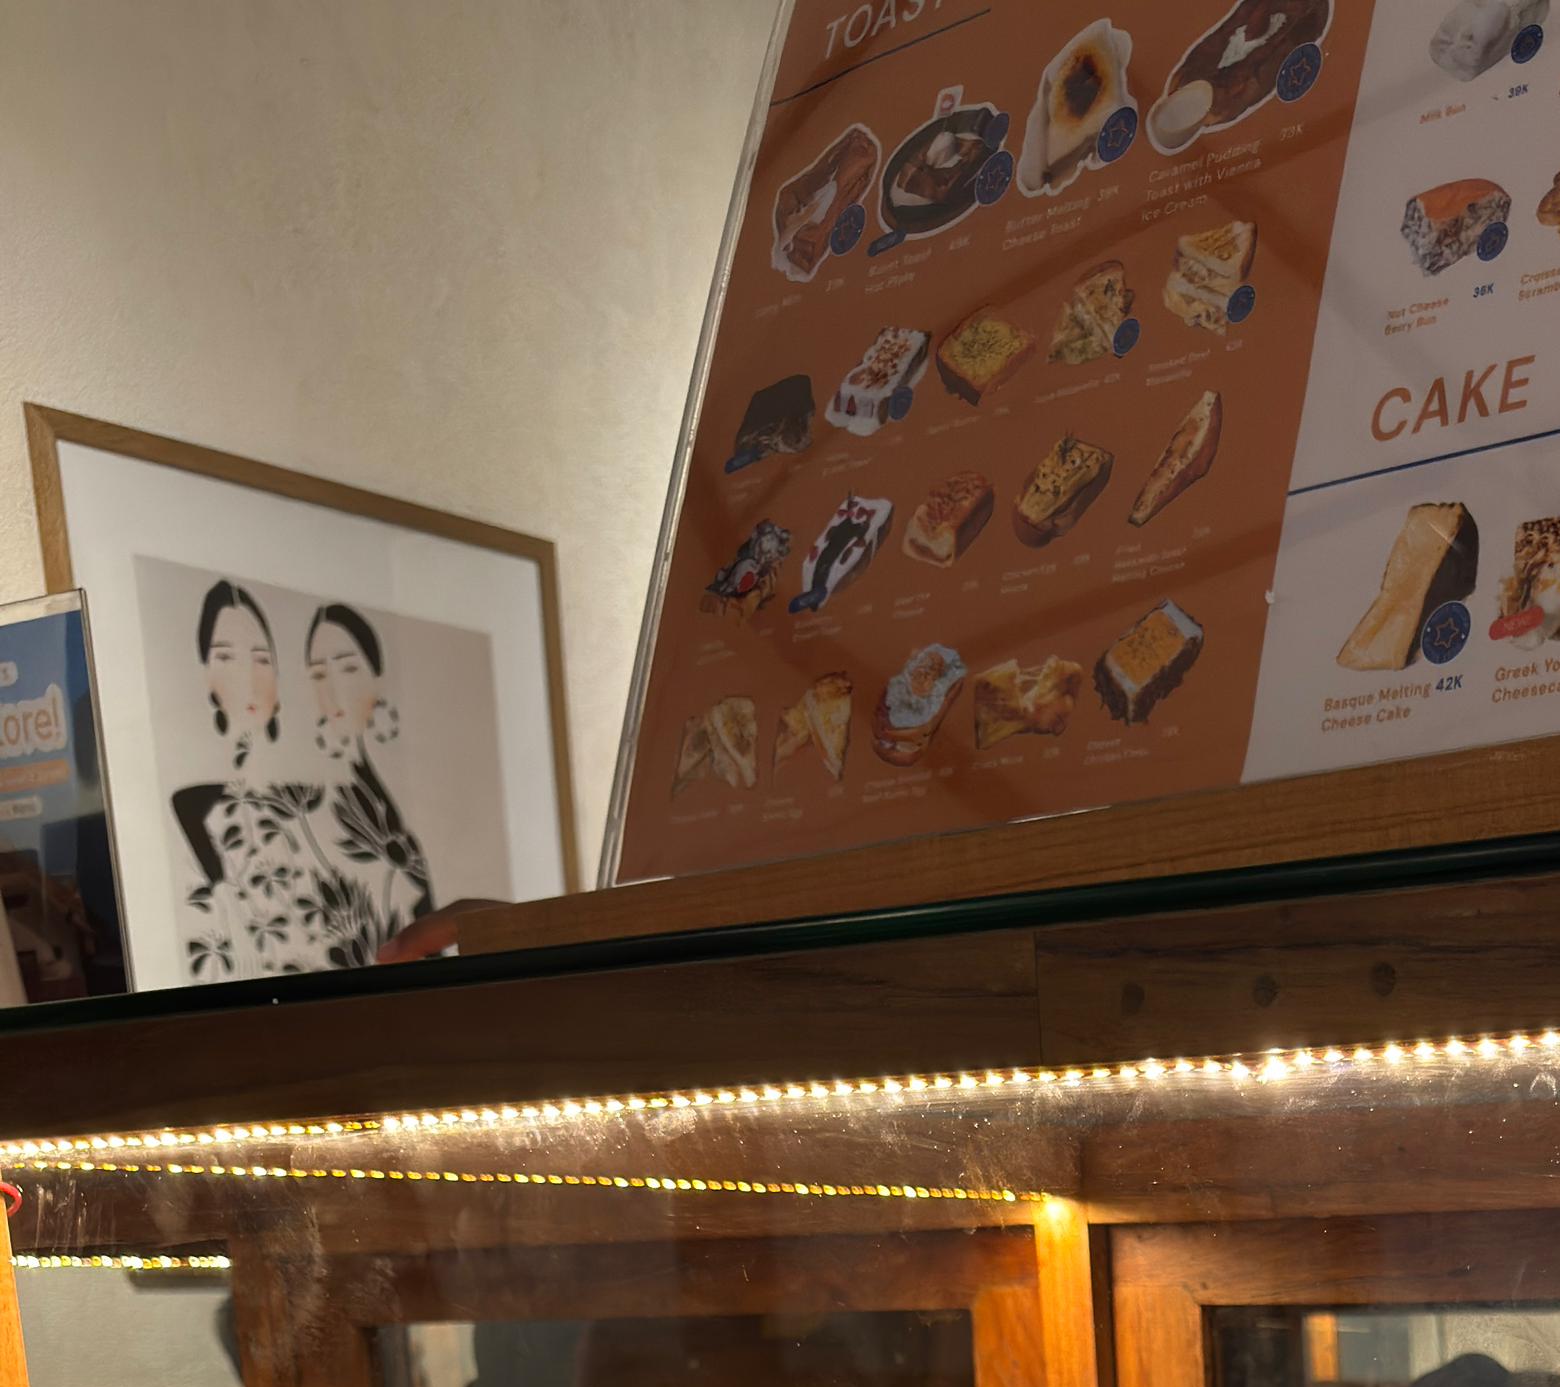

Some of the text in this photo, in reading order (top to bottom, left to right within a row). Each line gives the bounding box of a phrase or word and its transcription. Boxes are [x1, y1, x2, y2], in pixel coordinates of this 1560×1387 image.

[1371, 354, 1537, 442] CAKE
[1435, 674, 1464, 692] 42K
[1494, 662, 1538, 682] Greek
[1324, 682, 1433, 712] Basque Melting
[1320, 705, 1411, 733] Cheese Cake
